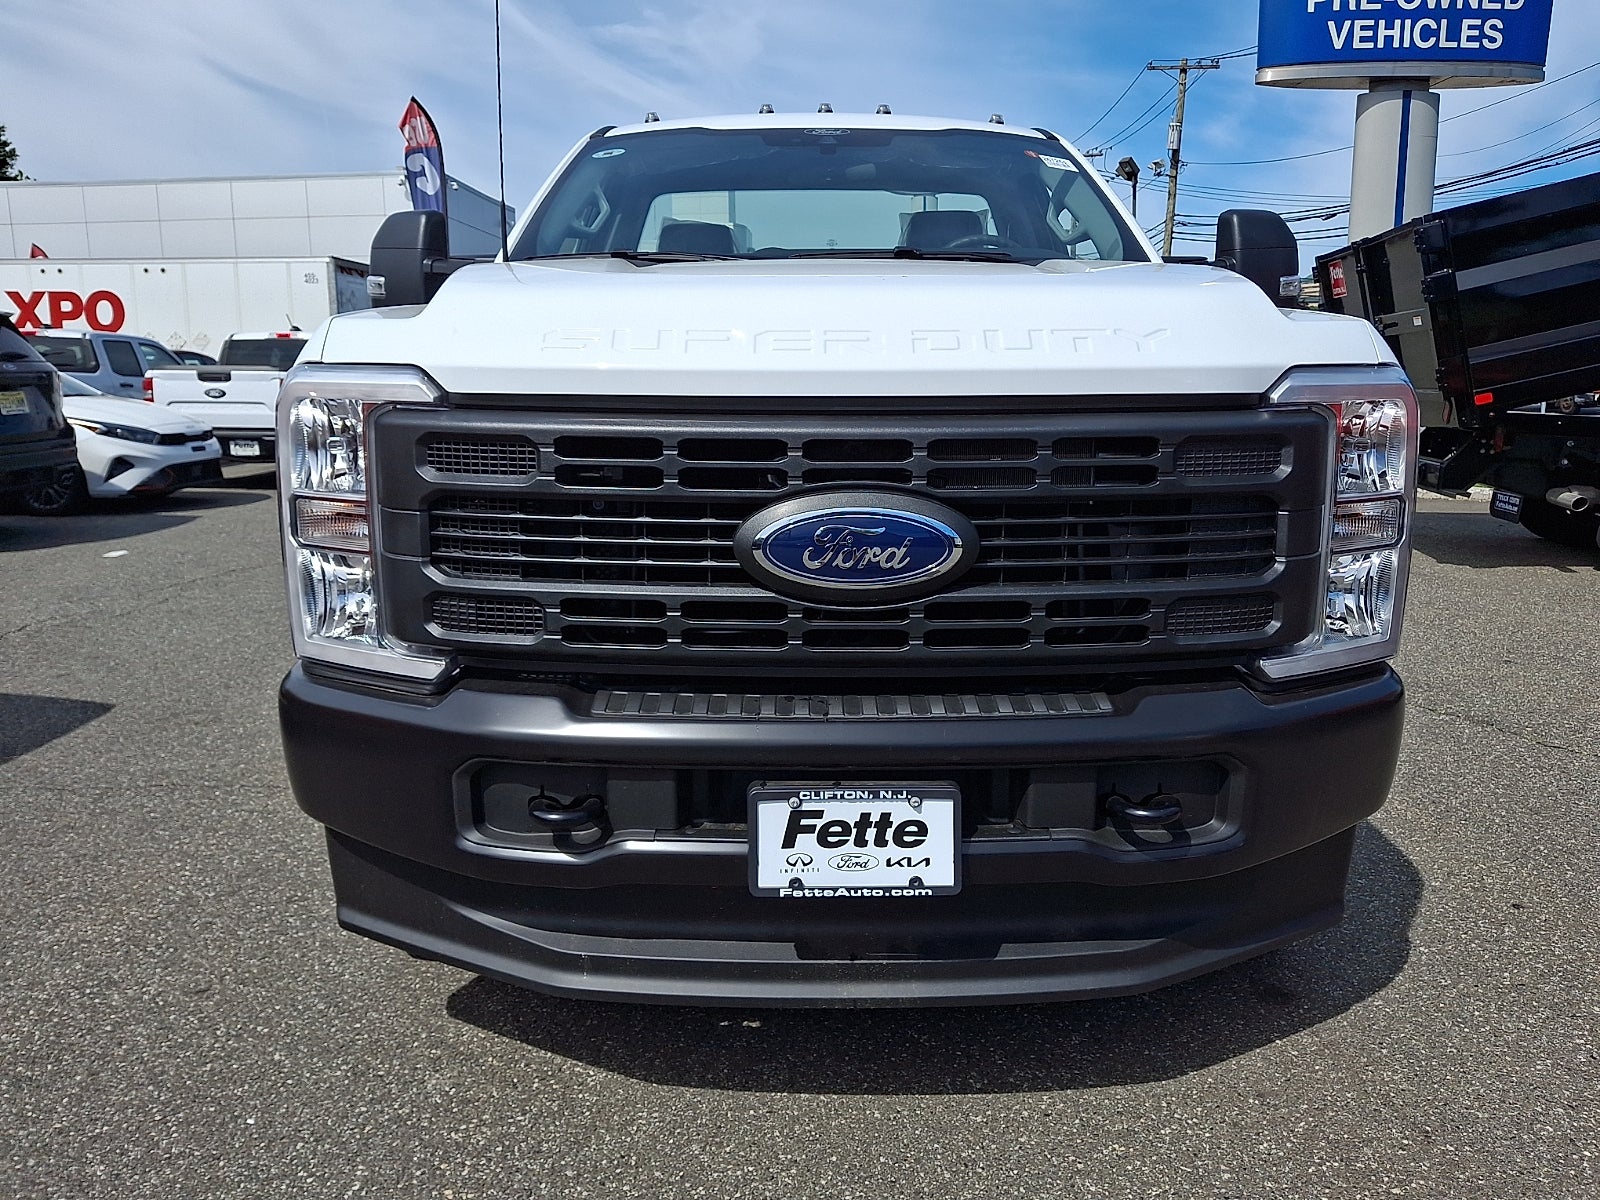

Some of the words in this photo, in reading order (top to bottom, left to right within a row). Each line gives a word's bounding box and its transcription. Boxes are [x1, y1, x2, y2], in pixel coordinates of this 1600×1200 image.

[1328, 18, 1504, 49] VEHICLES
[4, 290, 125, 333] XPO
[538, 328, 888, 354] SUPER
[910, 328, 1171, 354] DUTY
[802, 524, 914, 570] Ford
[799, 790, 873, 800] CLIFTON,
[879, 790, 912, 800] N.J.
[781, 809, 929, 849] Fette
[836, 855, 871, 869] Ford
[885, 856, 931, 868] KIA
[779, 888, 933, 898] FetteAuto.com
